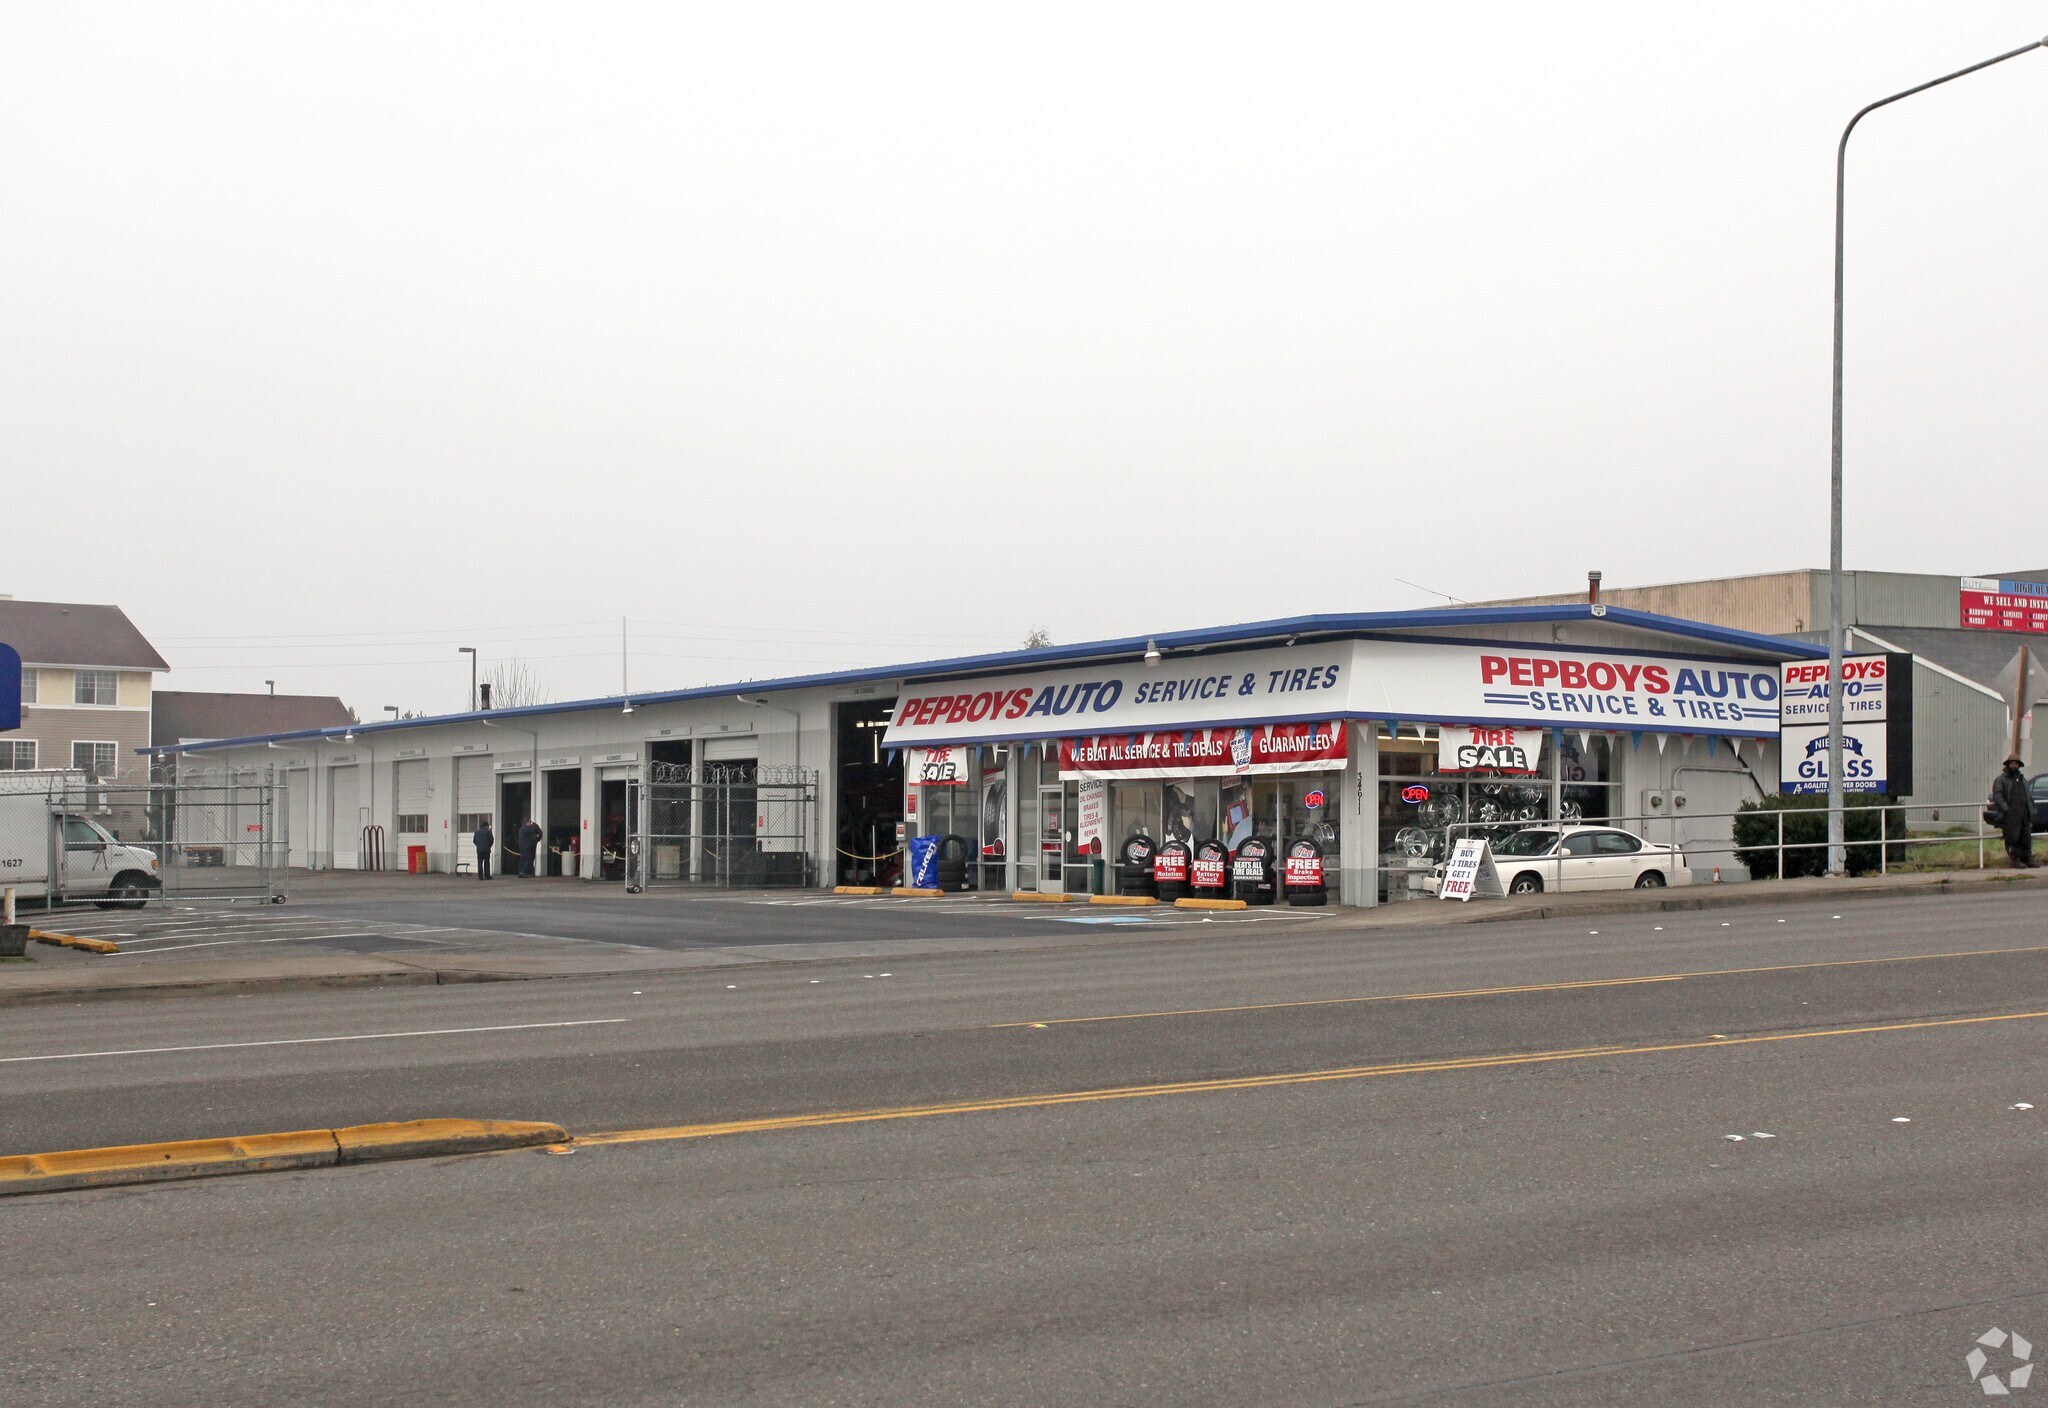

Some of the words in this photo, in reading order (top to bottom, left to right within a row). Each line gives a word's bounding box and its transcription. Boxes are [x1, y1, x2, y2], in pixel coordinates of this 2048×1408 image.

[2014, 582, 2033, 593] HIGH
[1983, 595, 1994, 605] WE
[1996, 596, 2011, 607] SELL
[2014, 598, 2027, 608] AND
[1785, 661, 1886, 683] PEPOYS
[1480, 655, 1670, 694] PEPBOYS
[1673, 668, 1778, 701] AUTO
[896, 687, 1034, 727] PEPBOYS
[1025, 679, 1124, 718] AUTO
[1134, 675, 1232, 704] SERVICE
[1238, 672, 1256, 697] &
[1267, 665, 1340, 694] TIRES
[1529, 691, 1638, 715] SERVICE
[1648, 697, 1666, 717] &
[1673, 699, 1743, 722] TIRES
[1850, 700, 1882, 711] TIRES
[1469, 728, 1515, 746] TIRE
[1814, 738, 1853, 750] NIEEN
[1071, 748, 1085, 762] WE
[1109, 745, 1124, 760] ALL
[1125, 743, 1161, 760] SERVICE
[1162, 743, 1171, 758] &
[1173, 742, 1191, 758] TIRE
[1192, 740, 1223, 757] DEALS
[1459, 748, 1526, 769] SALE
[1797, 759, 1874, 778] GLSS
[1080, 779, 1103, 793] SERVICE
[1086, 791, 1103, 802] CHANGE
[1402, 787, 1428, 801] OPEN
[1304, 793, 1324, 807] OPEN
[1083, 801, 1099, 812] BRAKES
[1083, 812, 1094, 821] TIRES
[1084, 828, 1098, 837] REPAIR
[1460, 849, 1475, 858] BUY
[2, 859, 22, 868] 1627
[1155, 856, 1185, 866] FREE
[1193, 861, 1224, 872] FREE
[1287, 858, 1320, 869] FREE
[1457, 860, 1477, 868] TIRES
[1246, 868, 1263, 876] DEALS
[1452, 870, 1464, 878] GET
[1445, 880, 1471, 893] FREE
